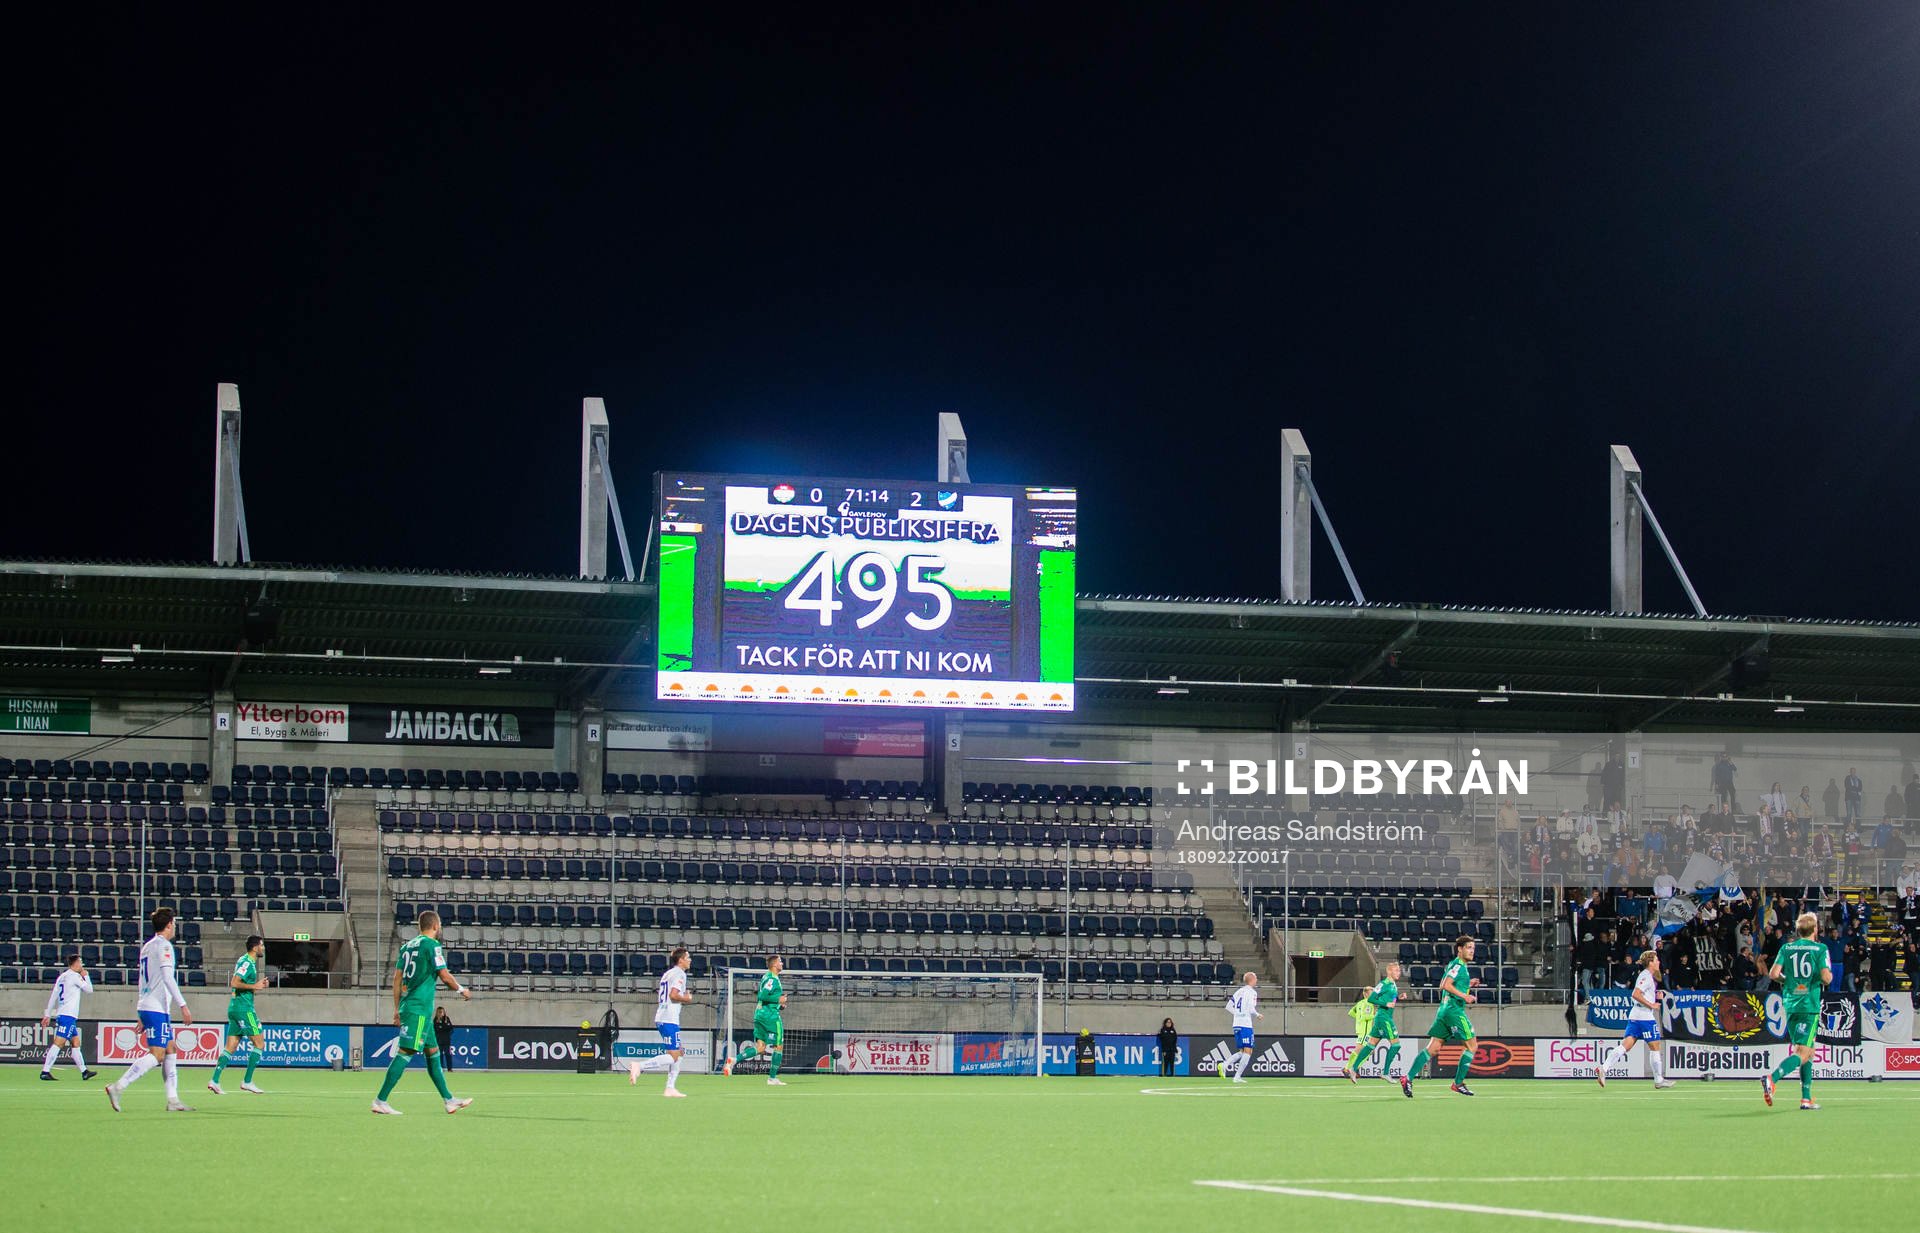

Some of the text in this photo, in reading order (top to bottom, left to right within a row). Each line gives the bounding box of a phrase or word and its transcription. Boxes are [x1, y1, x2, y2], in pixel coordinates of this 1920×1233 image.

[810, 488, 922, 508] 0 71:14 2
[734, 512, 1000, 541] DAGENS PUBLIKSIFFRA
[784, 550, 953, 631] 495
[736, 643, 992, 674] TACK FÖR ATT NI KOM
[8, 700, 58, 714] HUSMAN
[237, 702, 345, 724] Ytterbom
[23, 716, 49, 730] NIAN
[220, 718, 226, 726] R
[386, 710, 500, 742] JAMBACK
[250, 726, 329, 738] El, Bygg & Måleri
[590, 730, 597, 738] R
[951, 738, 958, 747] S
[1298, 748, 1304, 756] S
[1631, 756, 1637, 765] T
[1790, 952, 1812, 978] 16
[59, 984, 64, 1000] 2
[1236, 996, 1243, 1012] 4
[1589, 996, 1635, 1008] OMPA
[1594, 1007, 1630, 1020] SNOK
[0, 1022, 82, 1048] ögstr
[295, 1026, 321, 1040] FÖR
[236, 1041, 321, 1053] NSIRATION
[498, 1037, 600, 1060] Lenov
[627, 1046, 706, 1056] Dansk ank
[866, 1040, 932, 1052] Gästrike
[870, 1053, 930, 1066] Plåt AB
[1043, 1044, 1117, 1065] FLYAR
[1124, 1046, 1144, 1065] IN
[1669, 1045, 1770, 1072] Magasinet
[960, 1062, 979, 1072] BÄST
[980, 1060, 1002, 1070] MUSIK
[1002, 1058, 1020, 1068] JUST
[1197, 1060, 1240, 1072] adias
[1252, 1060, 1296, 1072] adidas
[1372, 1068, 1402, 1076] Faest
[1572, 1068, 1584, 1076] Be
[1822, 1068, 1834, 1077] The
[1836, 1068, 1864, 1078] Fastest
